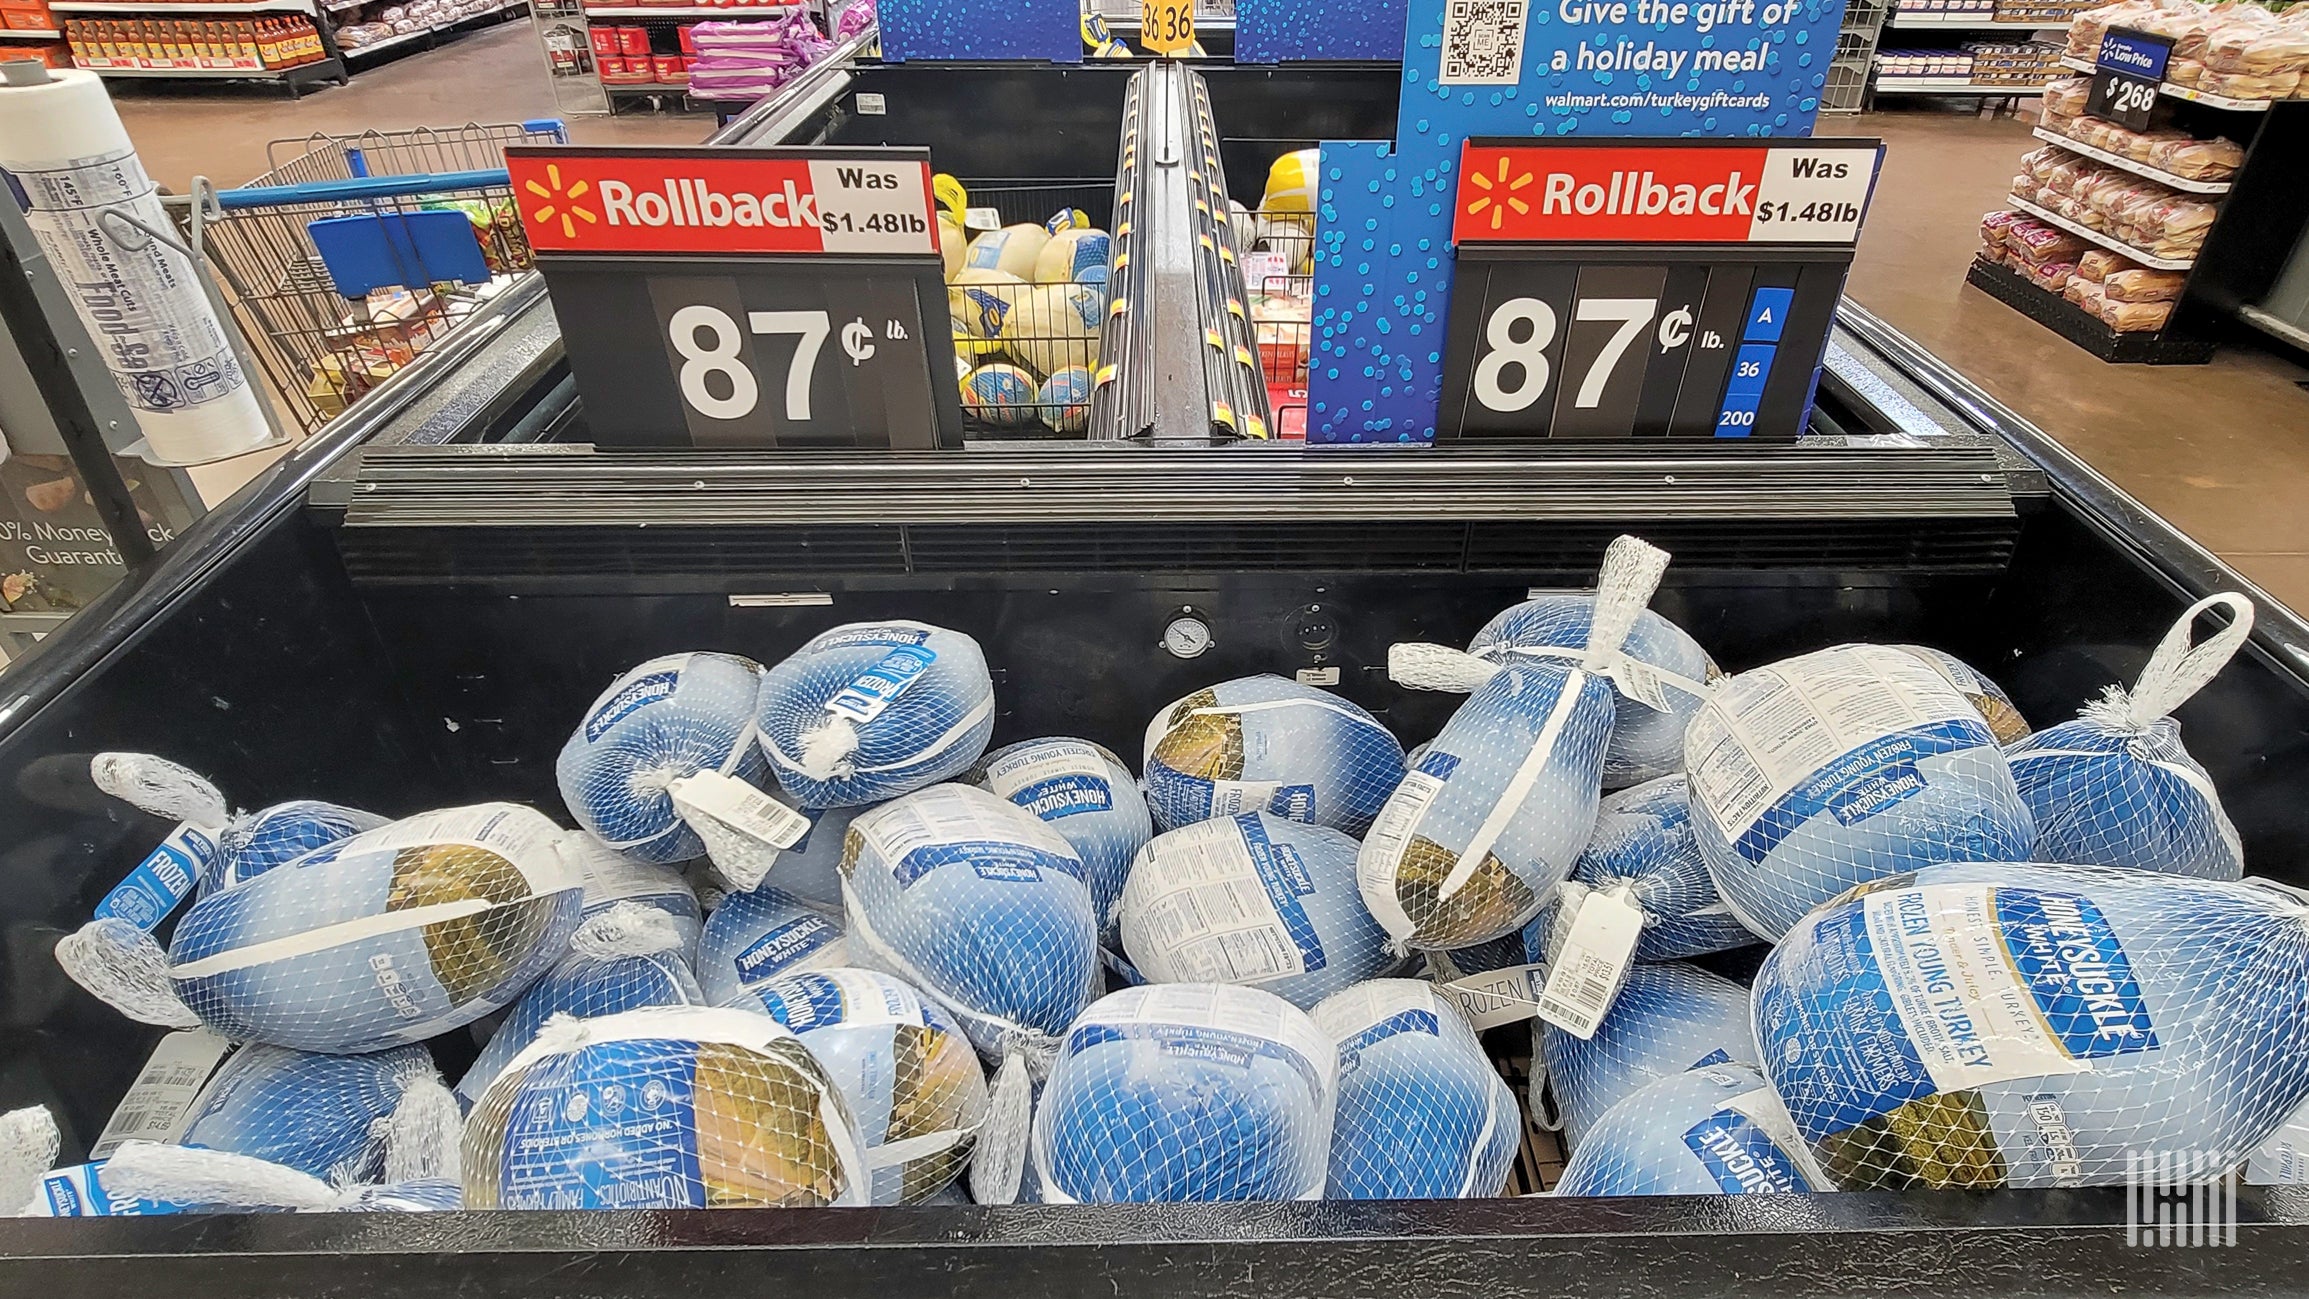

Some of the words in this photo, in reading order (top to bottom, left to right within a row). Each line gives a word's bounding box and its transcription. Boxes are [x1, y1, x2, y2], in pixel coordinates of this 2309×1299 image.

[1143, 6, 1160, 42] 36
[1165, 6, 1192, 43] 36
[1559, 0, 1628, 24] Give
[1637, 0, 1686, 24] the
[1696, 0, 1754, 32] gift
[1762, 0, 1799, 24] of
[1477, 38, 1489, 46] ME
[1551, 48, 1568, 72] a
[1576, 41, 1688, 80] holiday
[1693, 41, 1771, 71] meal
[2114, 48, 2132, 63] Low
[2131, 52, 2152, 68] Price
[1545, 92, 1770, 112] walmart.com/turkeygiftcards
[110, 165, 133, 199] 160°F
[837, 167, 899, 190] Was
[1790, 158, 1849, 180] Was
[58, 174, 84, 209] 145°F
[599, 177, 821, 229] Rollback
[1542, 171, 1756, 217] Rollback
[822, 212, 926, 236] $1.48lb
[1756, 200, 1859, 225] $1.48lb
[86, 227, 112, 264] Whole
[104, 260, 126, 291] Meat
[119, 288, 138, 313] Cuts
[1757, 306, 1773, 325] A
[885, 320, 909, 341] lb.
[1701, 330, 1726, 349] lb.
[1736, 360, 1760, 378] 36
[1718, 410, 1756, 428] 200
[32, 521, 114, 547] Money
[147, 523, 175, 543] ck
[25, 546, 124, 566] Guarant
[816, 633, 918, 650] HONEYSUCKLE
[588, 680, 671, 736] HONEYSUCKLE
[1029, 749, 1062, 765] YOUNG
[1873, 738, 1913, 764] FROZEN
[995, 757, 1029, 779] TURKEY
[1840, 755, 1875, 782] YOUNG
[1039, 781, 1077, 797] WHITE
[1804, 770, 1841, 799] TURKEY
[1843, 772, 1921, 821] HONEYSUCKLE
[1021, 790, 1106, 817] HONEYSUCKL
[1744, 783, 1771, 814] NUTRITION
[146, 849, 195, 899] FROZEN
[1278, 843, 1312, 893] HONEYSUCKLE
[1897, 892, 1932, 937] FROZEN
[741, 917, 829, 971] HONEYSUCKLE
[770, 938, 810, 963] WHITE
[2025, 923, 2063, 988] WHITE
[1909, 937, 1953, 994] YOUNG
[2041, 895, 2143, 1042] HONEYSUCKLE
[1462, 975, 1524, 1018] ROZEN
[1934, 995, 1994, 1069] TURKEY
[1856, 1034, 1898, 1093] FARMERS
[2035, 1106, 2053, 1122] 150
[1698, 1124, 1776, 1192] SUCKLE
[599, 1178, 661, 1205] ANTIBIOTICS
